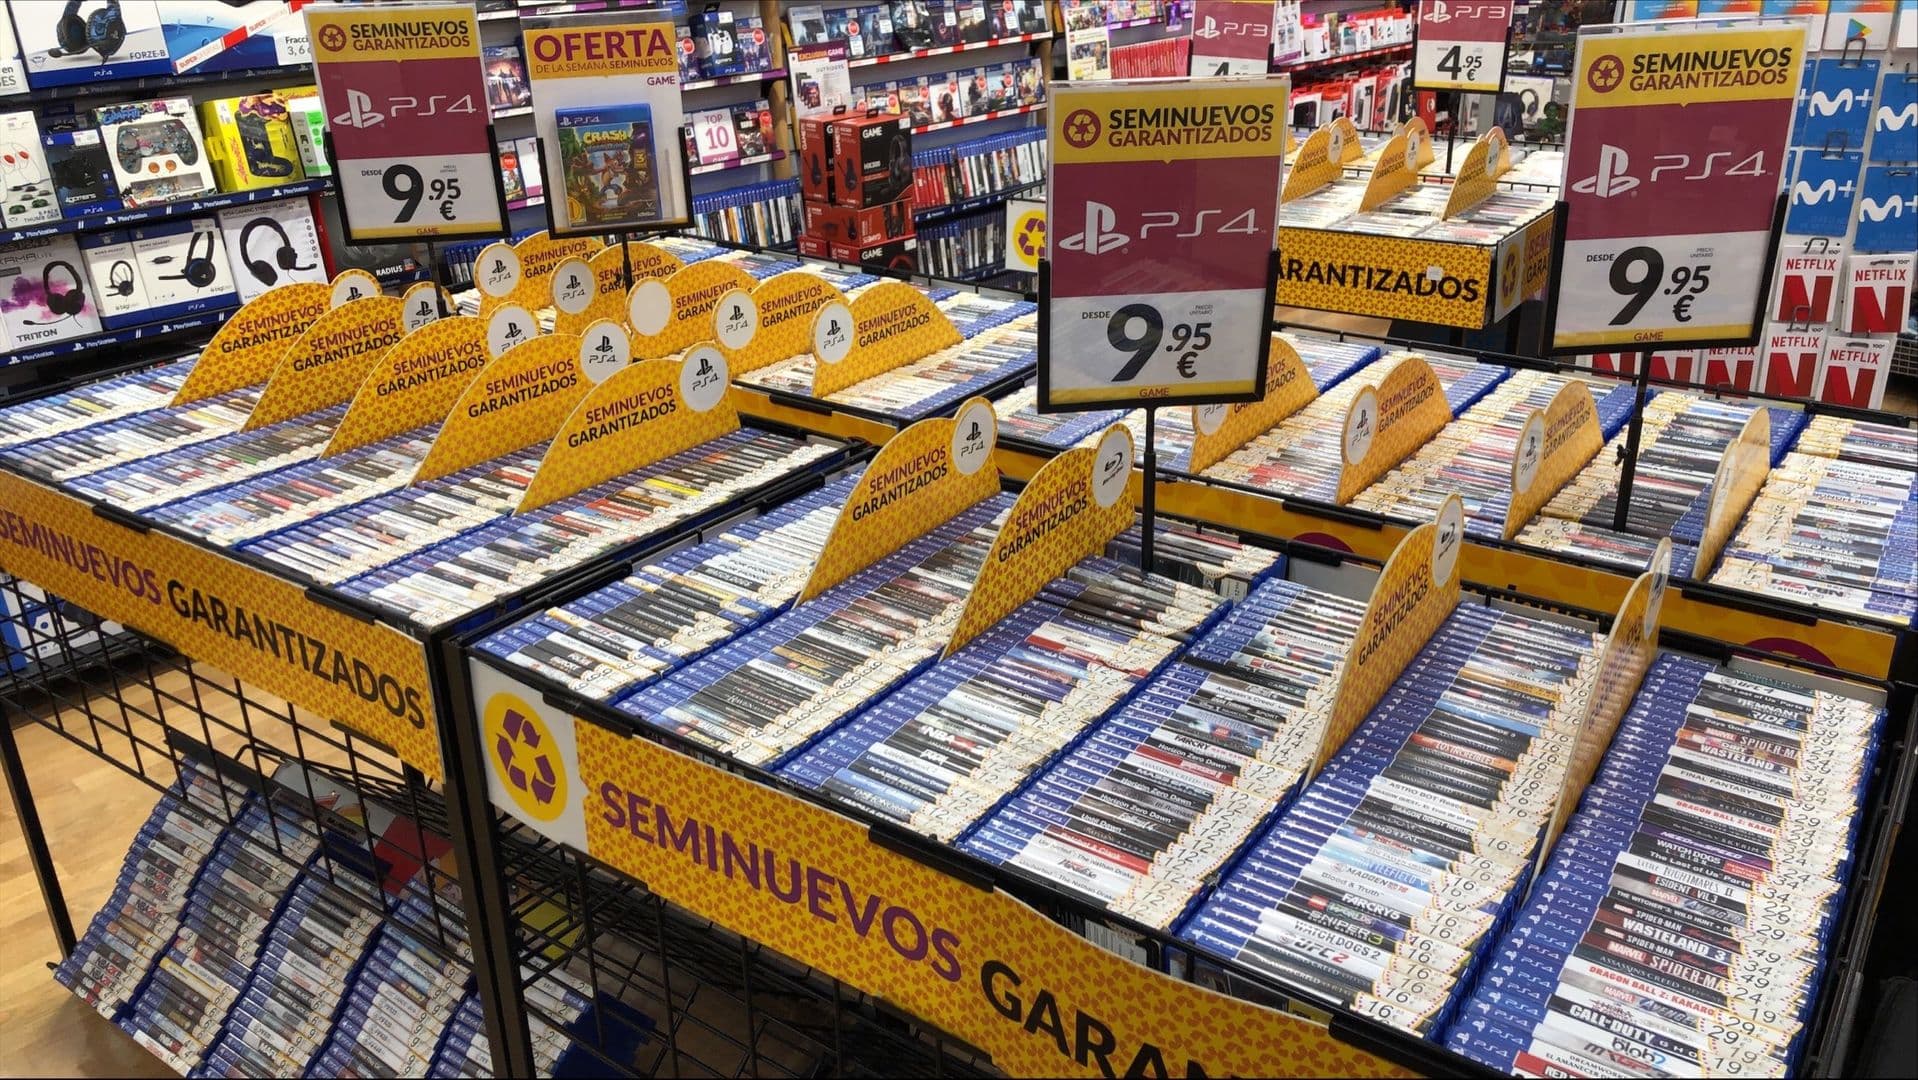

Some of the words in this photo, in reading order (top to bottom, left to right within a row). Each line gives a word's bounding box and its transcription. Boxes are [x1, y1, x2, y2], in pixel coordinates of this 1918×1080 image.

[1455, 6, 1505, 19] PS3
[351, 20, 468, 39] SEMINUEVOS
[1224, 22, 1268, 37] PS3
[353, 36, 470, 51] GARANTIZADOS
[533, 29, 672, 62] OFERTA
[828, 48, 844, 56] GAME
[129, 50, 166, 59] FORZE-B
[1632, 47, 1792, 75] SEMINUEVOS
[536, 65, 549, 73] DE
[552, 64, 564, 72] LA
[566, 62, 608, 72] SEMANA
[610, 58, 673, 69] SEMINUEVOS
[1467, 69, 1477, 81] €
[646, 76, 676, 86] GAME
[1629, 68, 1788, 92] GARANTIZADOS
[388, 94, 477, 118] PS4
[574, 115, 600, 124] PS4
[704, 114, 723, 124] TOP
[1109, 104, 1274, 130] SEMINUEVOS
[705, 125, 729, 150] 10
[862, 126, 883, 139] GAME
[1108, 125, 1272, 148] GARANTIZADOS
[361, 169, 382, 177] DESDE
[1650, 150, 1766, 182] PS4
[439, 200, 457, 221] €
[26, 227, 58, 237] PlayStation
[416, 227, 439, 236] GAME
[1140, 208, 1259, 240] PS4
[524, 241, 587, 266] SEMINUEVOS
[861, 248, 883, 260] GAME
[1586, 253, 1615, 262] DESDE
[376, 266, 403, 277] RADIUS
[1786, 258, 1837, 271] NETFLIX
[488, 273, 512, 286] PS4
[1855, 269, 1907, 282] NETFLIX
[562, 289, 585, 300] PS4
[676, 279, 738, 309] SEMINUEVOS
[761, 285, 822, 314] SEMINUEVOS
[857, 304, 917, 334] SEMINUEVOS
[1081, 310, 1111, 320] DESDE
[1672, 295, 1695, 322] €
[238, 304, 325, 335] SEMINUEVOS
[725, 320, 749, 333] PS4
[859, 312, 930, 347] GARANTIZADOS
[16, 329, 58, 342] TRITTON
[309, 317, 397, 352] SEMINUEVOS
[823, 335, 845, 349] PS4
[1633, 332, 1663, 342] GAME
[1771, 336, 1820, 348] NETFLIX
[293, 332, 400, 372] GARANTIZADOS
[393, 341, 482, 376] SEMINUEVOS
[588, 355, 616, 364] PS4
[1829, 350, 1880, 365] NETFLIX
[377, 354, 485, 397] GARANTIZADOS
[1176, 351, 1198, 379] €
[485, 358, 575, 396] SEMINUEVOS
[691, 373, 720, 392] PS4
[468, 374, 577, 419] GARANTIZADOS
[1139, 388, 1169, 397] GAME
[585, 384, 674, 425] SEMINUEVOS
[1377, 383, 1435, 434] GARANTIZADOS
[567, 399, 677, 449] GARANTIZADOS
[961, 441, 985, 457] PS4
[870, 446, 946, 495] SEMINUEVOS
[852, 462, 947, 522] GARANTIZADOS
[1016, 476, 1087, 532] SEMINUEVOS
[998, 495, 1087, 563] GARANTIZADOS
[0, 508, 162, 605] SEMINUEVOS
[1373, 559, 1429, 626] SEMINUEVOS
[1358, 578, 1428, 666] GARANTIZADOS
[166, 579, 426, 731] GARANTIZADOS
[1158, 743, 1186, 757] Horizon
[1700, 744, 1775, 770] WASTELAND
[1680, 770, 1707, 782] FINAL
[1101, 794, 1129, 810] Horizon
[1131, 802, 1148, 814] Zero
[1150, 810, 1172, 824] Dawn
[1081, 813, 1098, 824] Until
[1100, 819, 1122, 833] Dawn
[600, 779, 963, 983] SEMINUEVOS
[1636, 910, 1682, 931] SPIDER-MAN
[1623, 917, 1709, 954] WASTELAND
[1714, 951, 1726, 962] 3
[1756, 925, 1786, 940] 29
[1607, 941, 1646, 962] MARVEL
[1626, 935, 1675, 957] SPIDER-MAN
[1752, 948, 1781, 963] 49
[1332, 952, 1350, 964] 2
[1744, 961, 1772, 976] 34
[1588, 966, 1629, 985] DRAGON
[1631, 978, 1656, 995] BALL
[1569, 1004, 1606, 1025] CALL
[1610, 1020, 1655, 1042] DUTY
[1708, 1025, 1739, 1044] 29
[1715, 1057, 1742, 1075] 19
